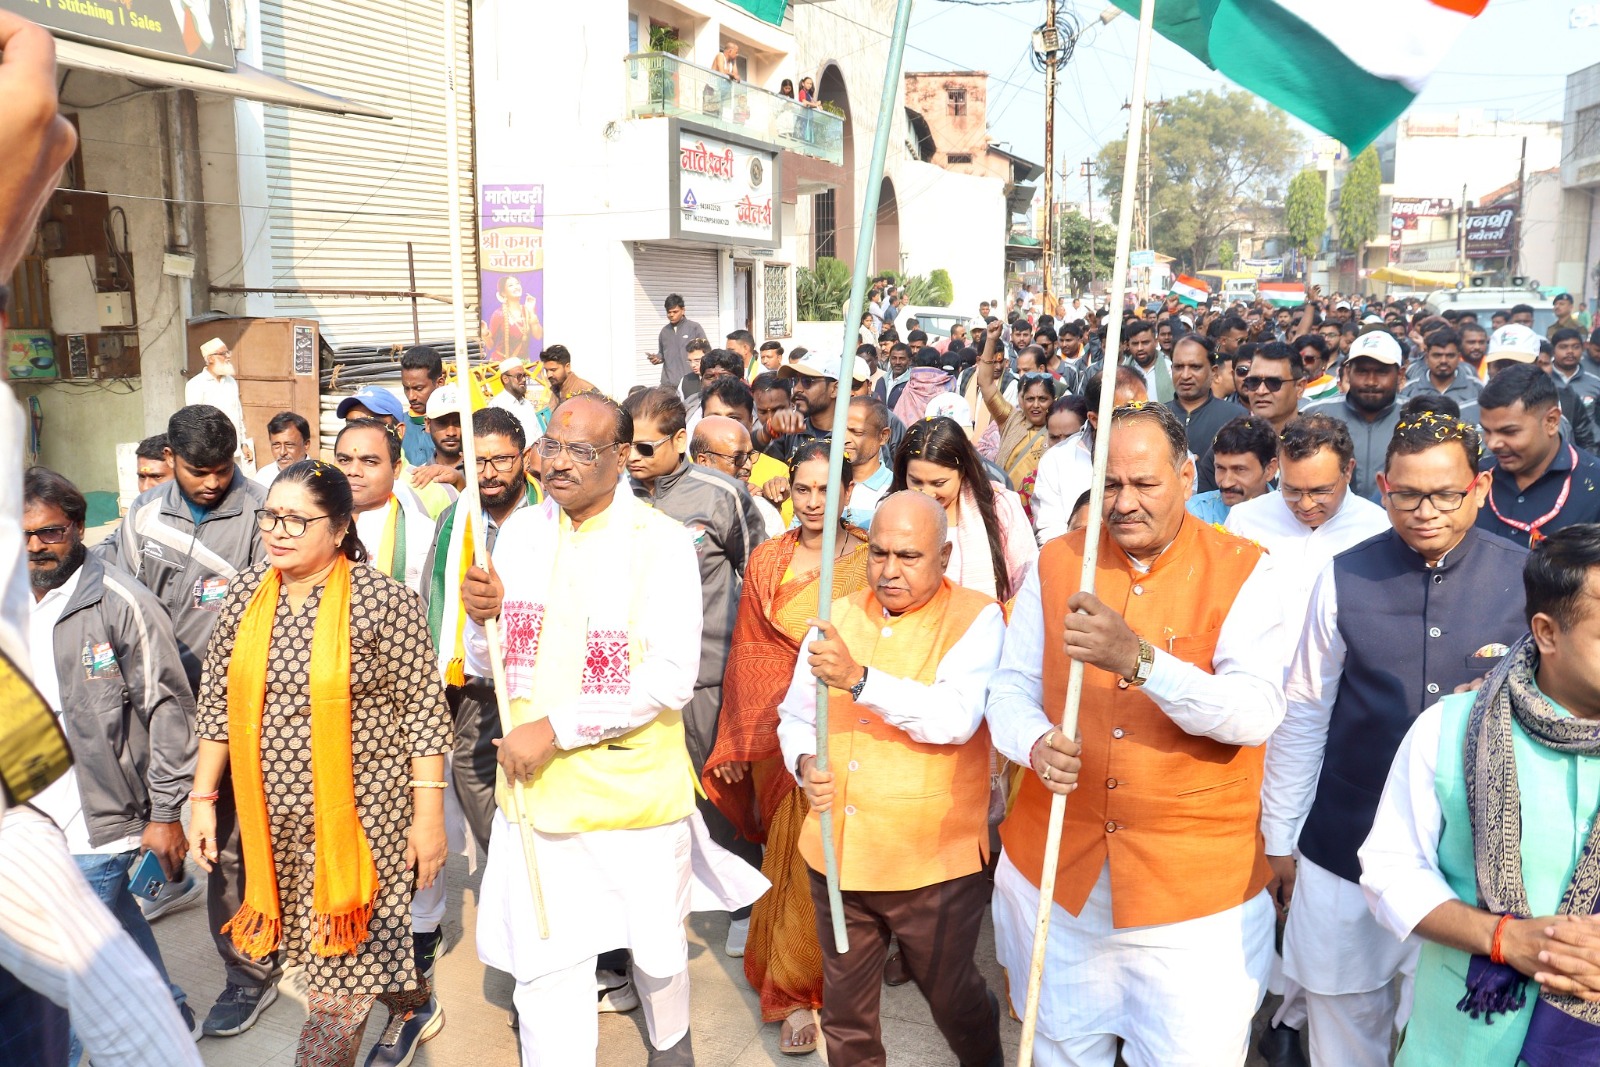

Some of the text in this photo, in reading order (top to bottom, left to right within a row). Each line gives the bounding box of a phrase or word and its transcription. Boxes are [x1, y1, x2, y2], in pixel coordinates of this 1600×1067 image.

[130, 13, 162, 33] Sales
[680, 141, 734, 178] मातेश्वरी
[484, 186, 542, 205] मातेश्वरी
[492, 205, 535, 223] ज्वेलर्स
[737, 194, 772, 225] ज्वेलर्स
[482, 232, 543, 249] श्री कमल
[490, 250, 534, 267] ज्वेलर्स
